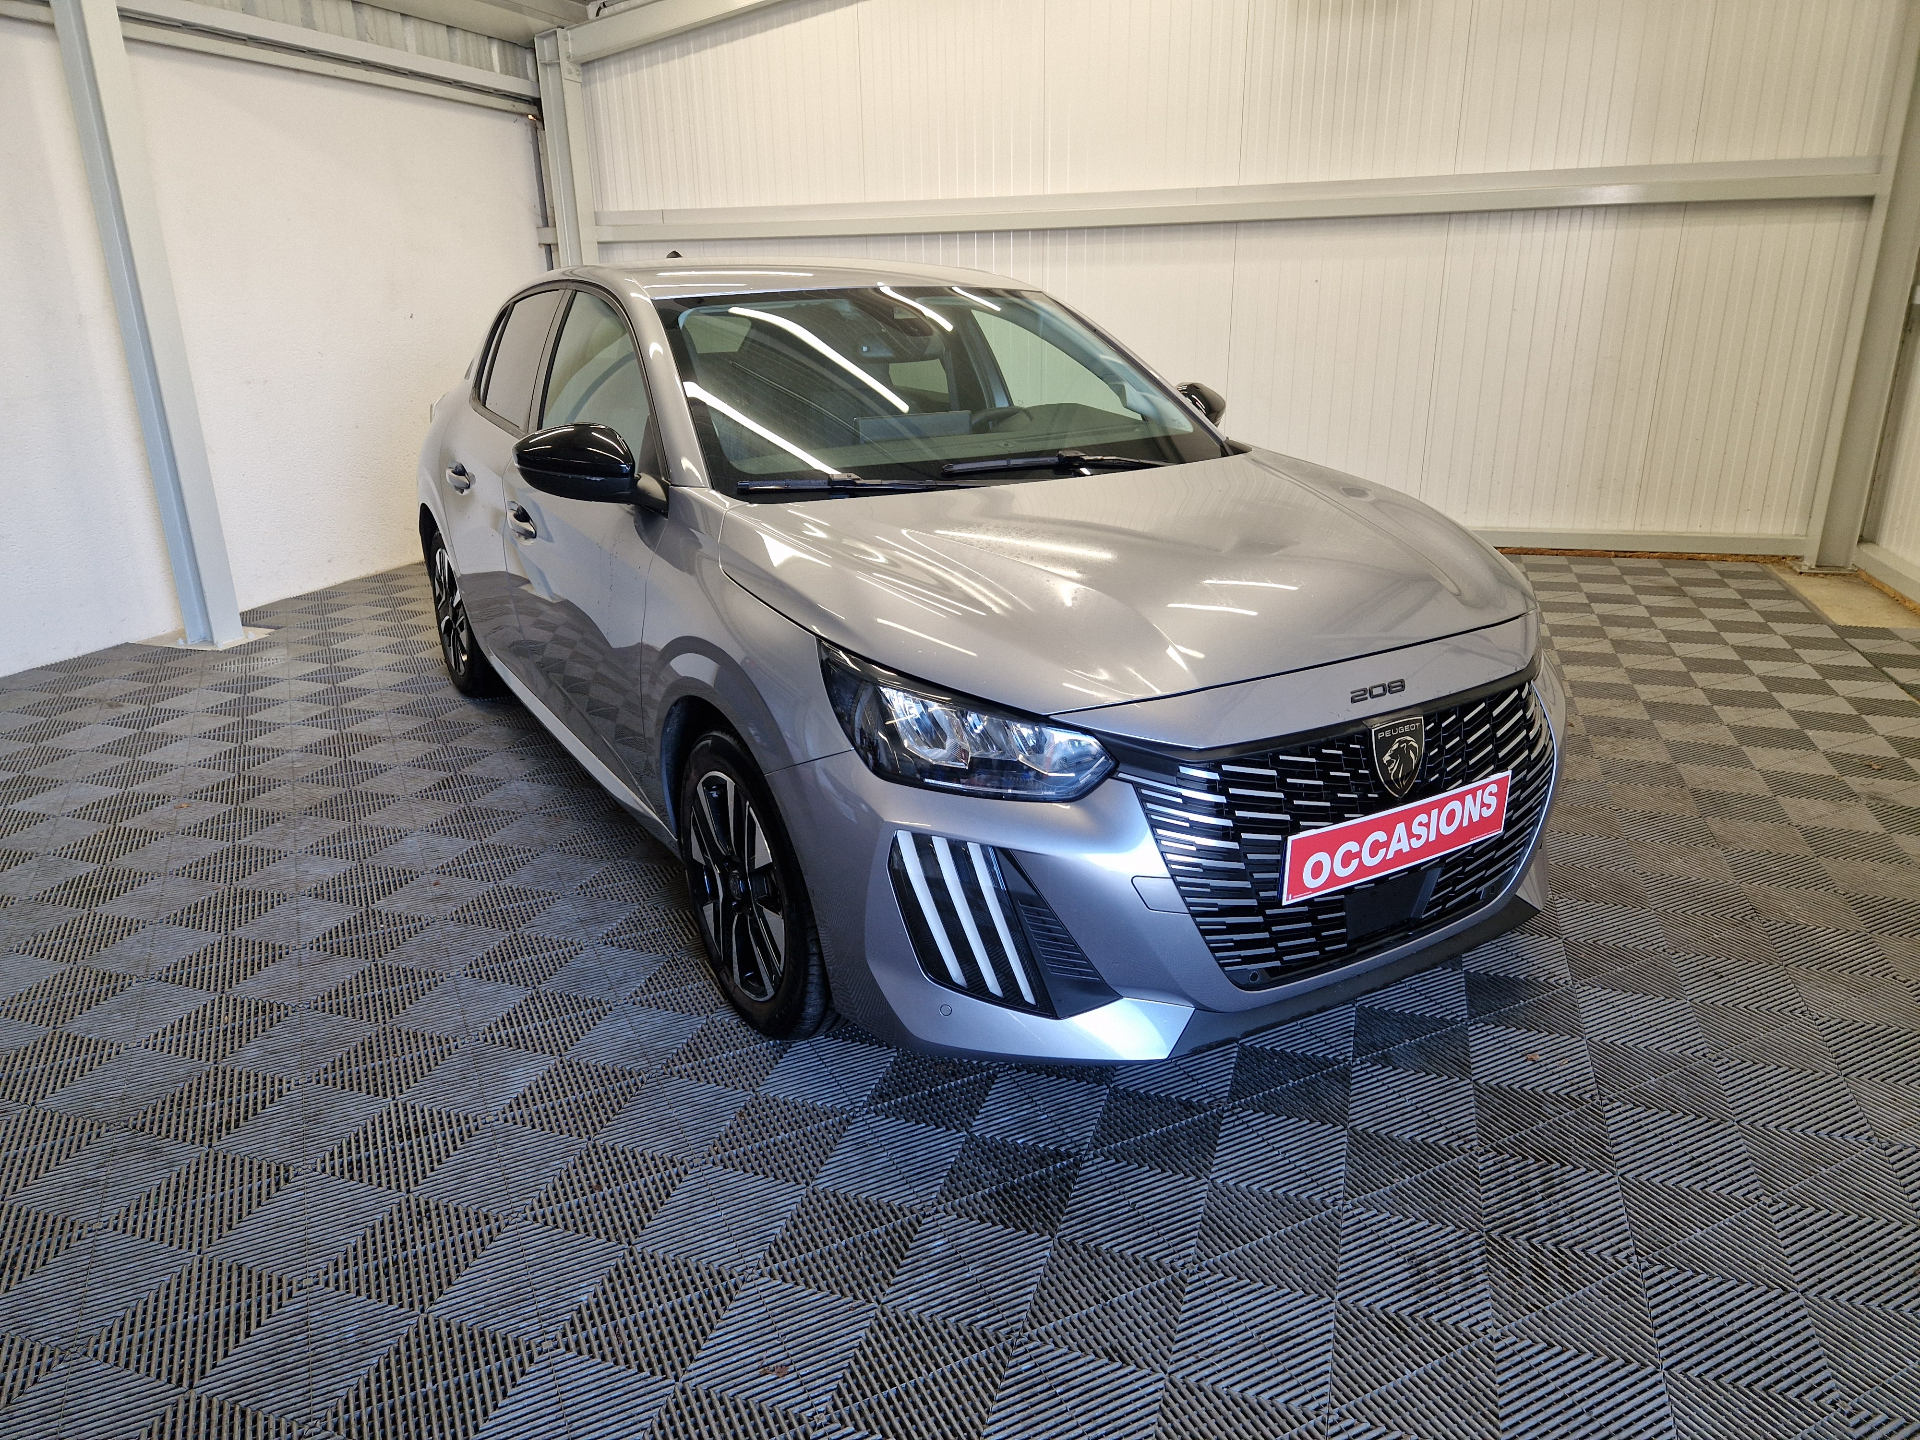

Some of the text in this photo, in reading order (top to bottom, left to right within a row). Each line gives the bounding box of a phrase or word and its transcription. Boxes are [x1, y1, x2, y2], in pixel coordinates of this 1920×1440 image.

[1350, 679, 1406, 704] 208
[1377, 722, 1421, 740] PEUGEOT
[1302, 783, 1498, 889] OCCASIONS
